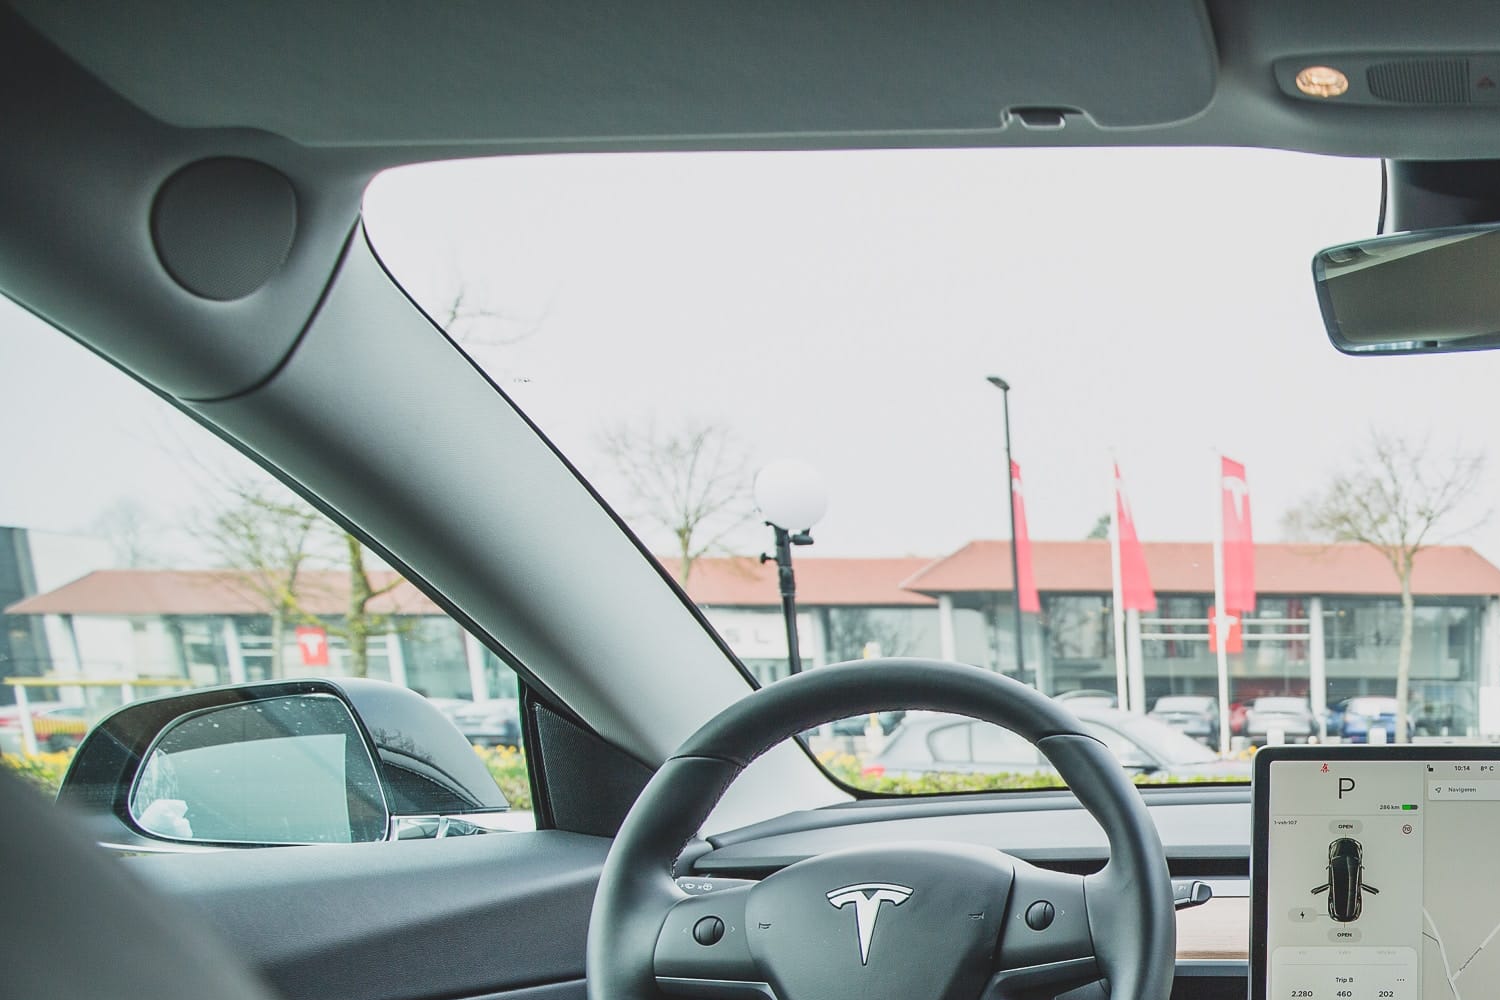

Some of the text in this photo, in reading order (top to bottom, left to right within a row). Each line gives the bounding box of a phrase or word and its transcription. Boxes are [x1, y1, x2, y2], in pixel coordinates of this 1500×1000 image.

[1338, 777, 1356, 799] P
[1291, 990, 1313, 998] 2.280
[1336, 990, 1353, 998] 460
[1378, 990, 1394, 998] 202
